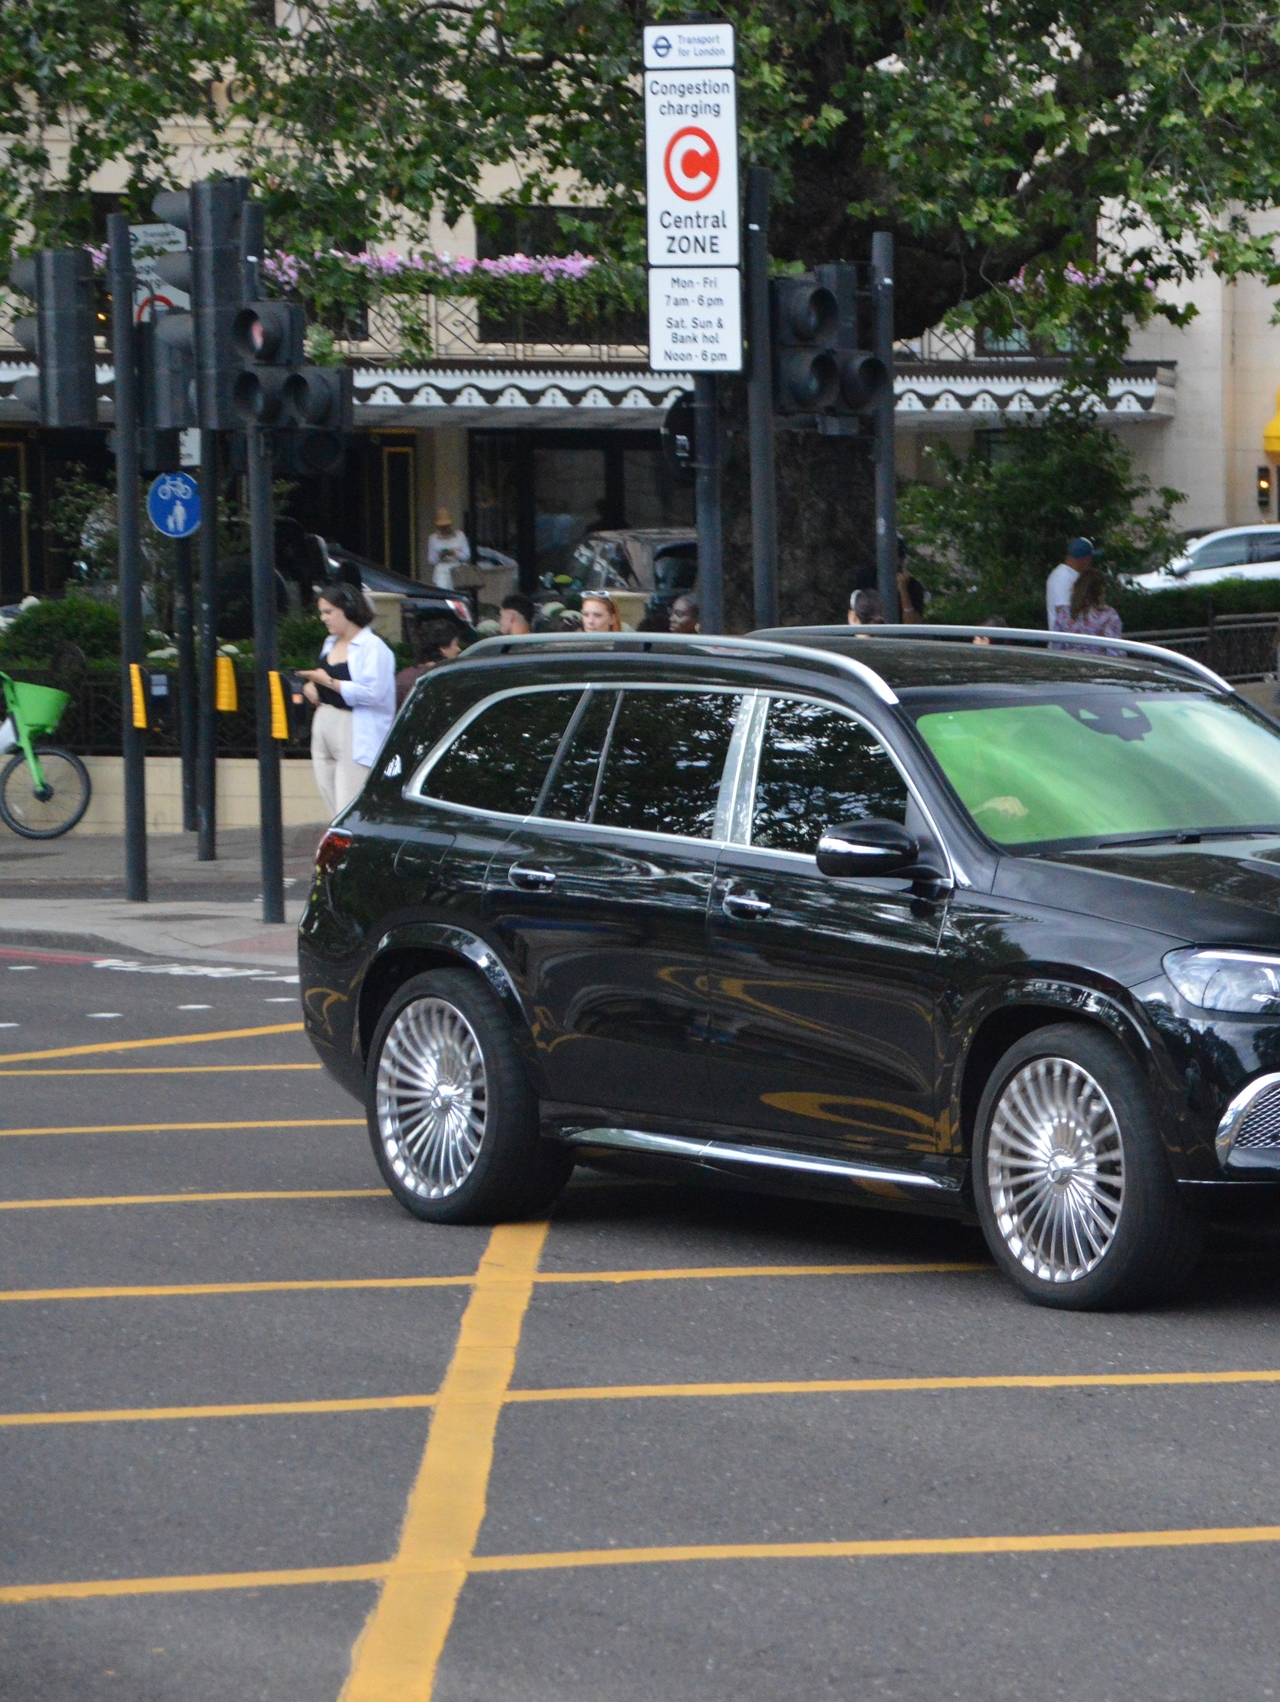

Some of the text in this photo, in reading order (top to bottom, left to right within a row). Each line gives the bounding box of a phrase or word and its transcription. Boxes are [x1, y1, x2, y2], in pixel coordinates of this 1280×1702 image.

[677, 35, 720, 46] Transport
[678, 47, 725, 57] for London
[649, 79, 730, 98] Congestion
[659, 99, 721, 118] charging
[659, 209, 727, 230] Central
[666, 235, 720, 254] ZONE
[670, 277, 695, 289] Mon
[703, 277, 718, 289] Fri
[691, 317, 713, 329] Sun
[671, 332, 720, 344] Bank hol
[664, 349, 693, 361] Noon
